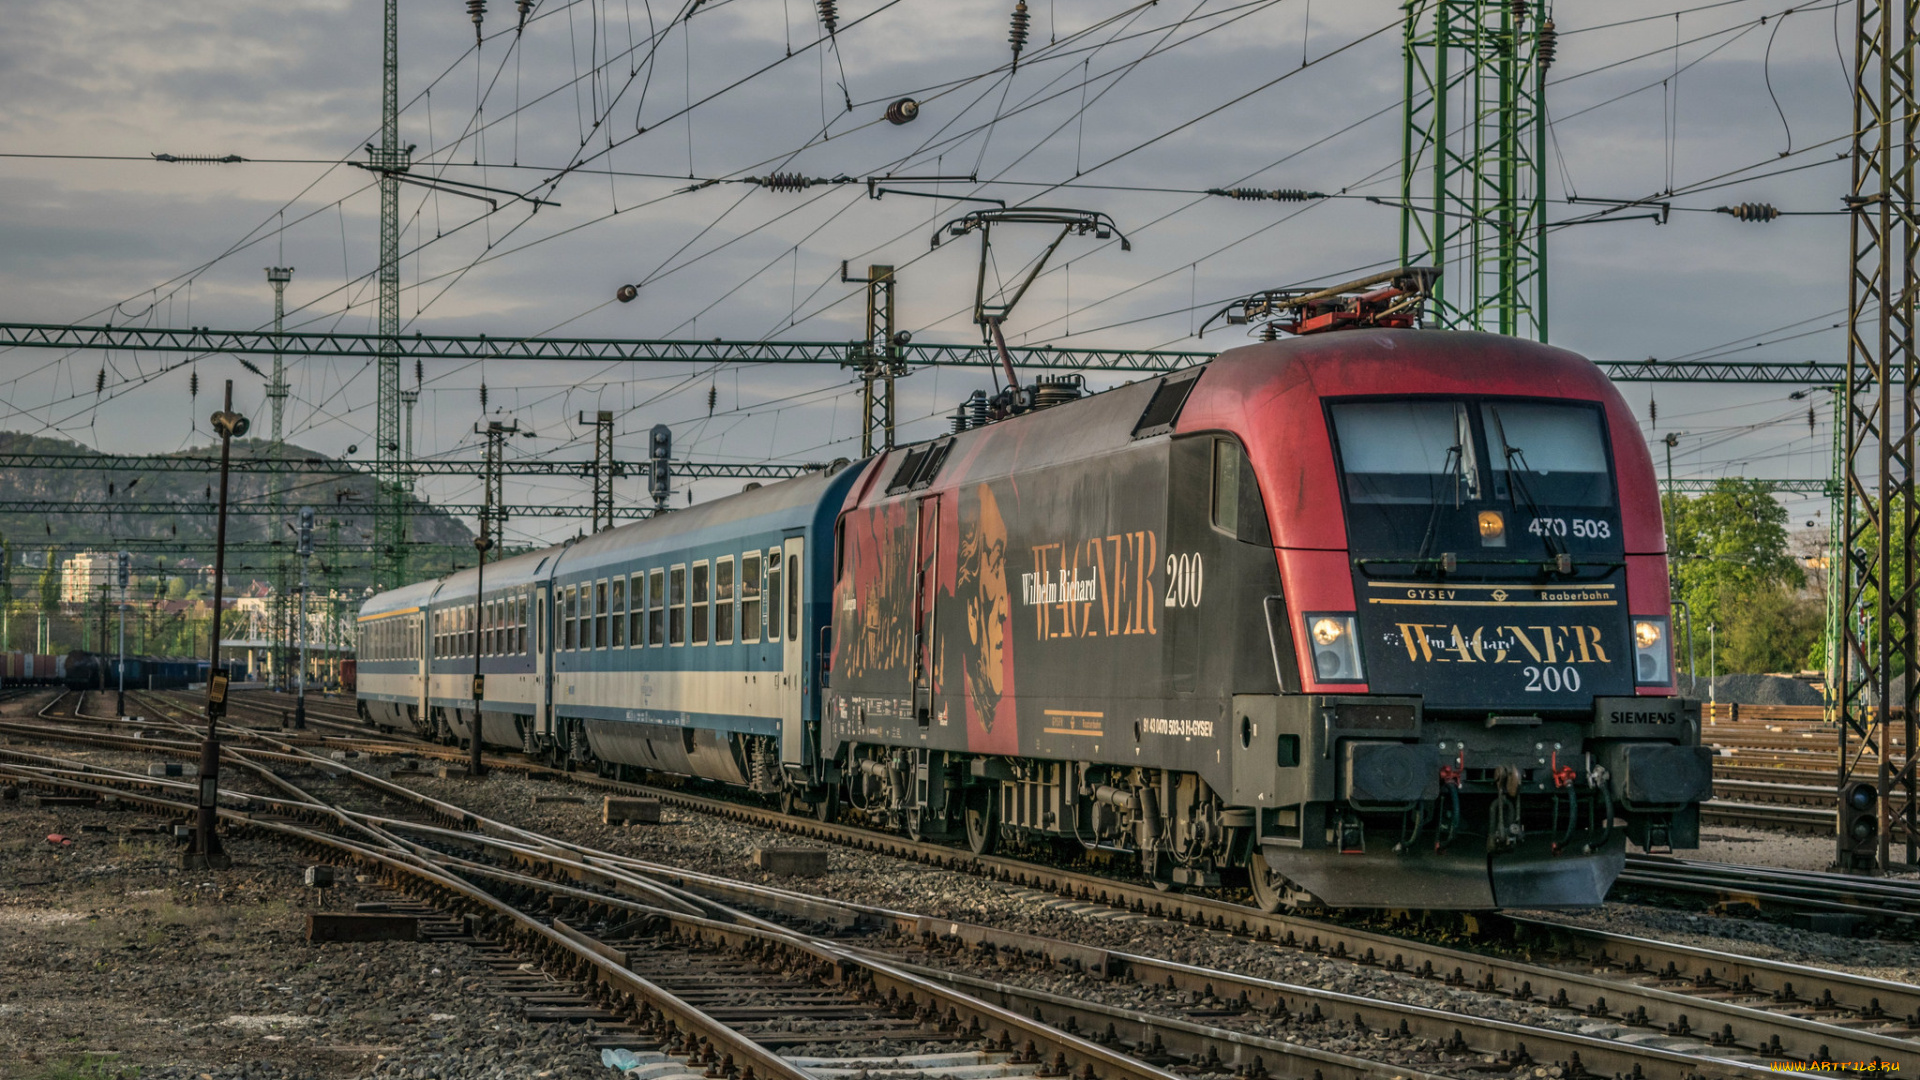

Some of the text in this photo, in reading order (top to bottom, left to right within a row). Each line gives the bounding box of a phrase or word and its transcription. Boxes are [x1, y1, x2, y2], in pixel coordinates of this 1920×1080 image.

[1528, 517, 1611, 539] 470 503
[1021, 565, 1097, 606] Wilhelm Richard
[1031, 529, 1203, 641] WAGNER 200
[1407, 589, 1610, 601] GYSEV Raaberbahn
[1395, 622, 1611, 664] WAGNER
[1523, 666, 1581, 693] 200
[1143, 717, 1149, 733] 91
[1150, 717, 1156, 734] 43
[1168, 719, 1185, 736] 503-3
[1185, 719, 1214, 738] H-GYSEV
[1610, 711, 1676, 725] SIEMENS
[1216, 748, 1221, 764] 1
